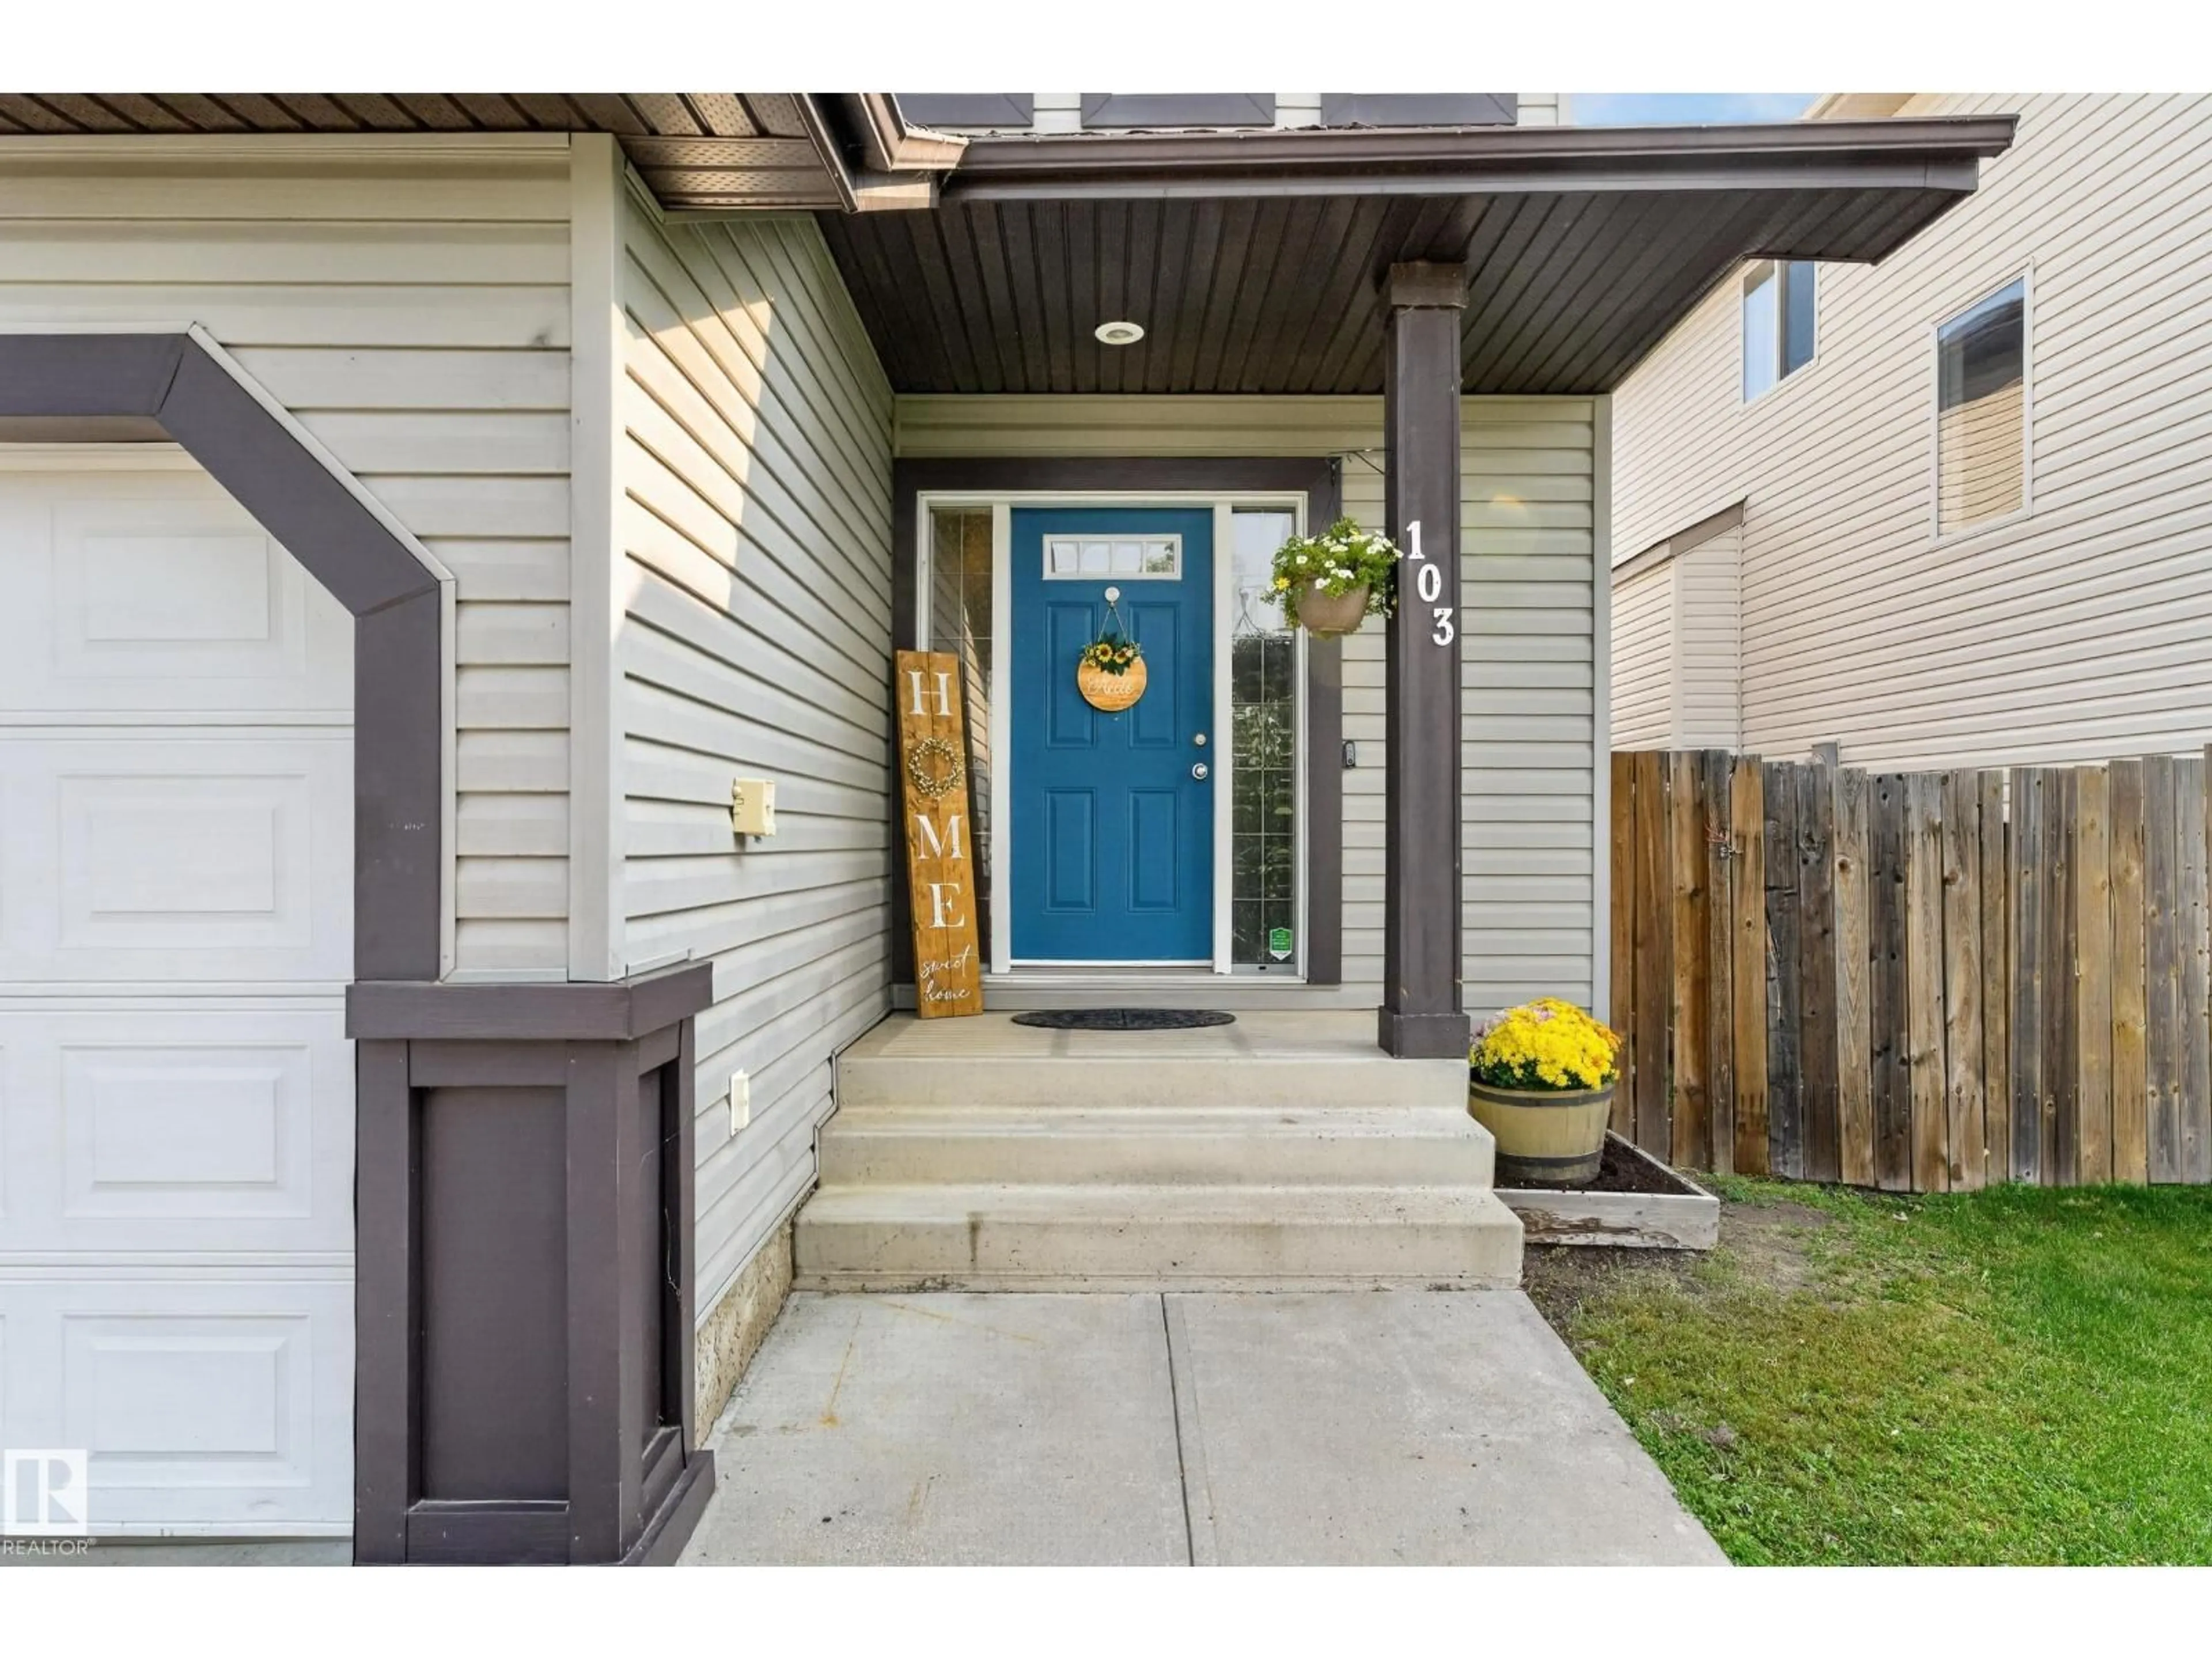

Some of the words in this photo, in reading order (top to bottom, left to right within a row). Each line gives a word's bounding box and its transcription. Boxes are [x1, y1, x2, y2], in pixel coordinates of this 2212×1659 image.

[1406, 520, 1455, 646] 103
[919, 943, 978, 979] sweet
[924, 979, 971, 1002] home
